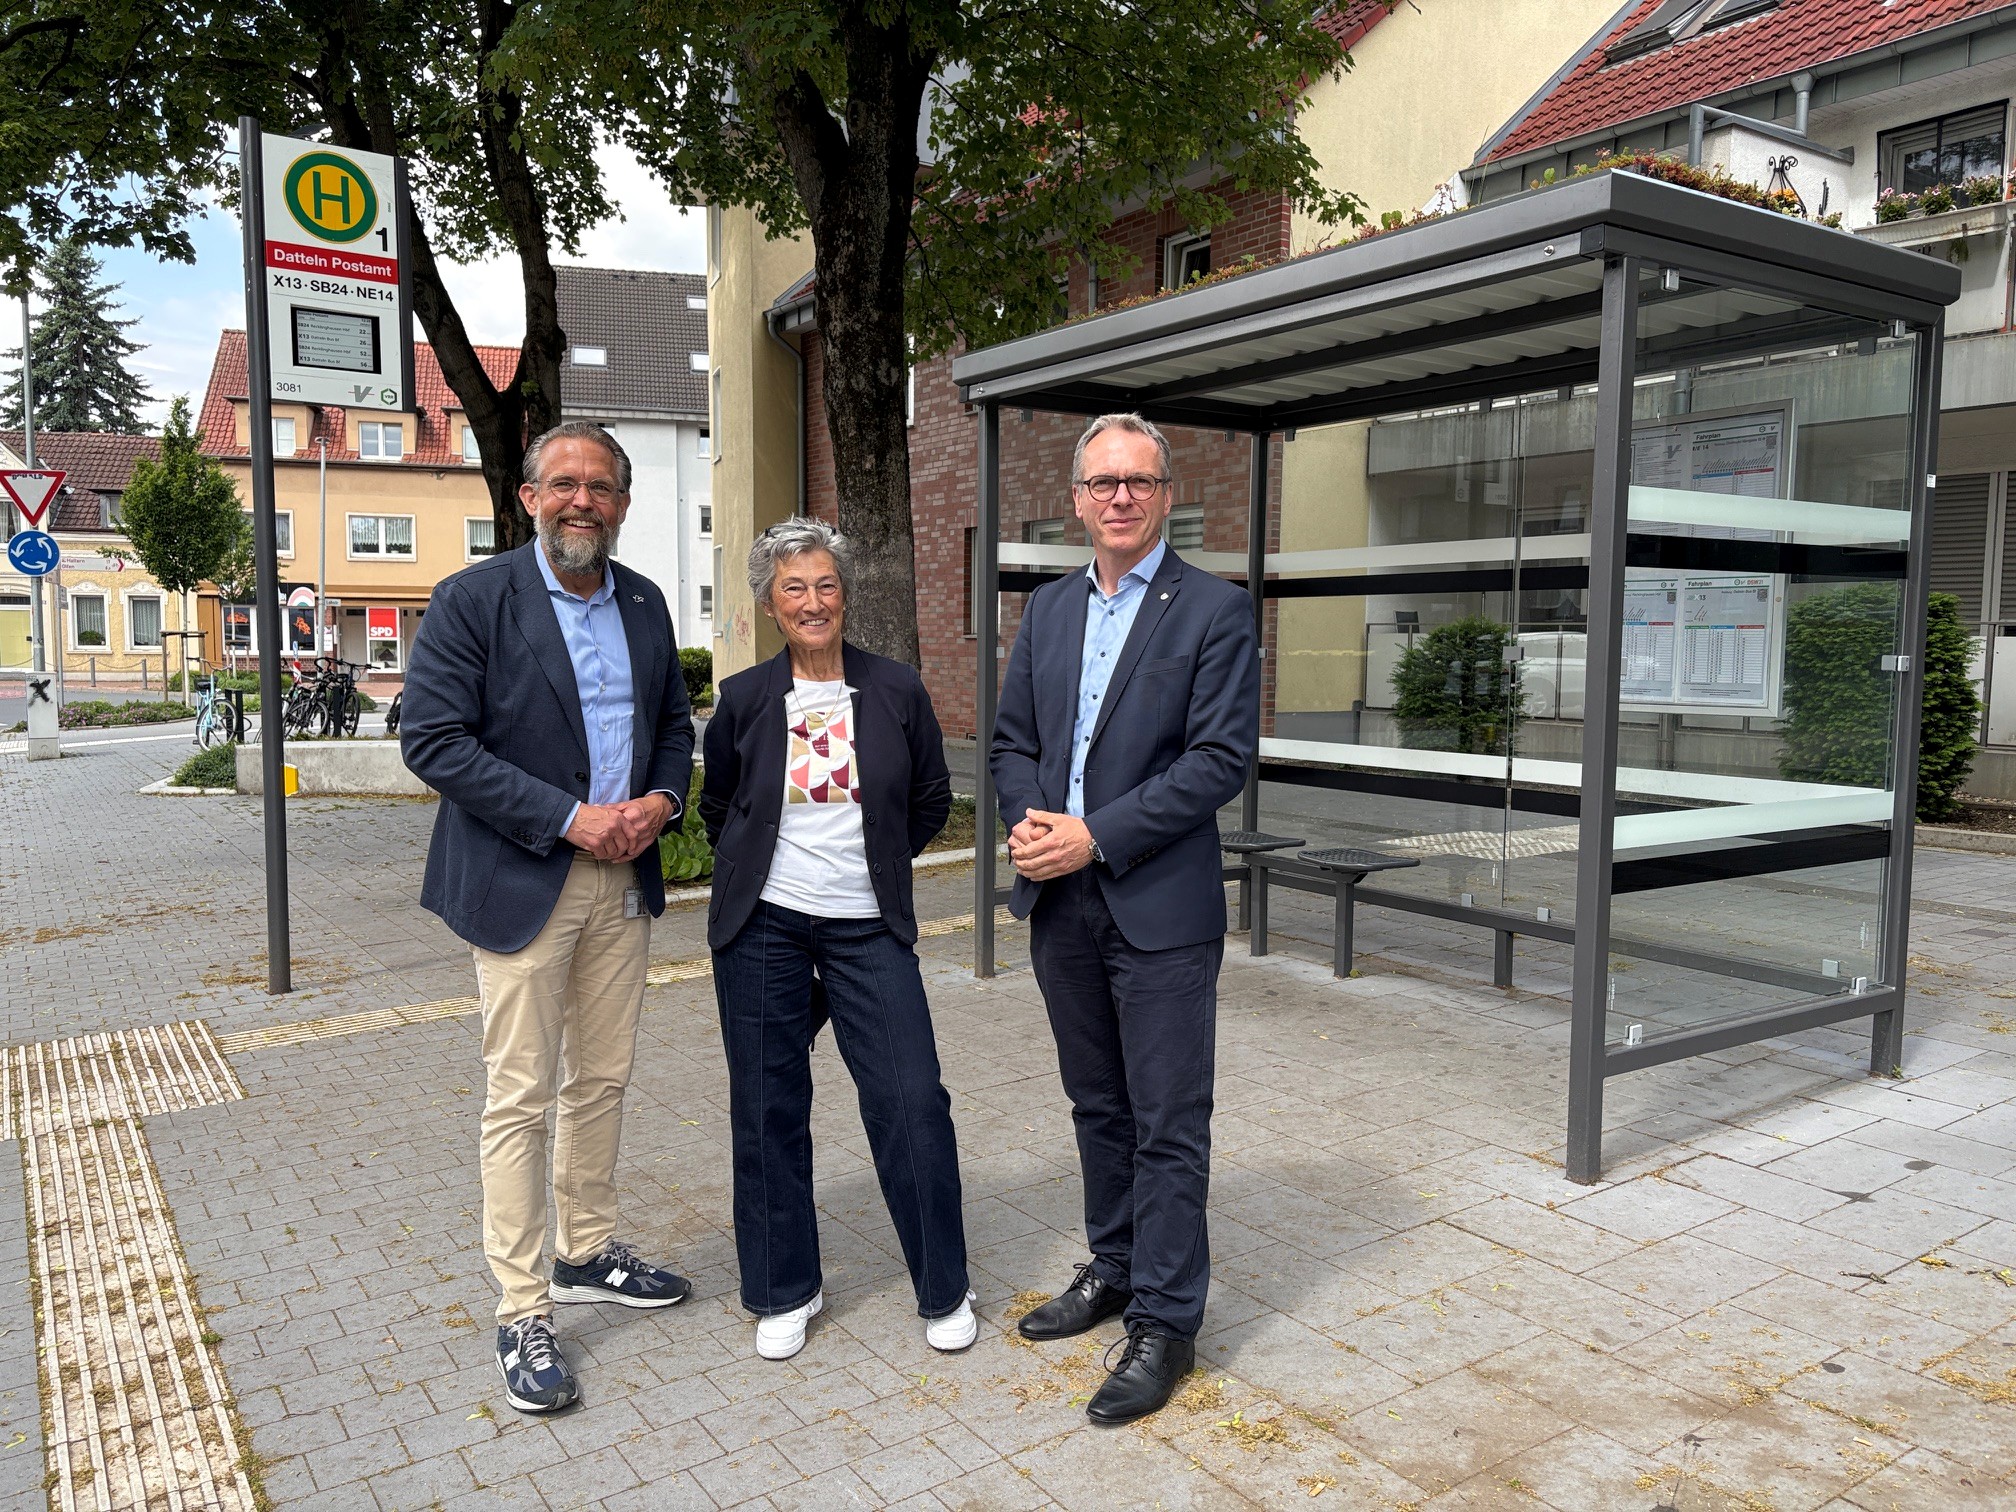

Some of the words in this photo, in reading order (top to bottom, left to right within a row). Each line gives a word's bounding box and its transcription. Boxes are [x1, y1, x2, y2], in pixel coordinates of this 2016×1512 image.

[312, 170, 351, 225] H
[375, 227, 388, 252] 1
[273, 248, 328, 268] Datteln
[332, 256, 392, 277] Postamt
[273, 274, 302, 290] X13
[310, 280, 349, 296] SB24
[356, 286, 394, 302] NE14
[276, 381, 302, 394] 3081
[1695, 433, 1722, 441] Fahrplan
[370, 626, 394, 637] SPD
